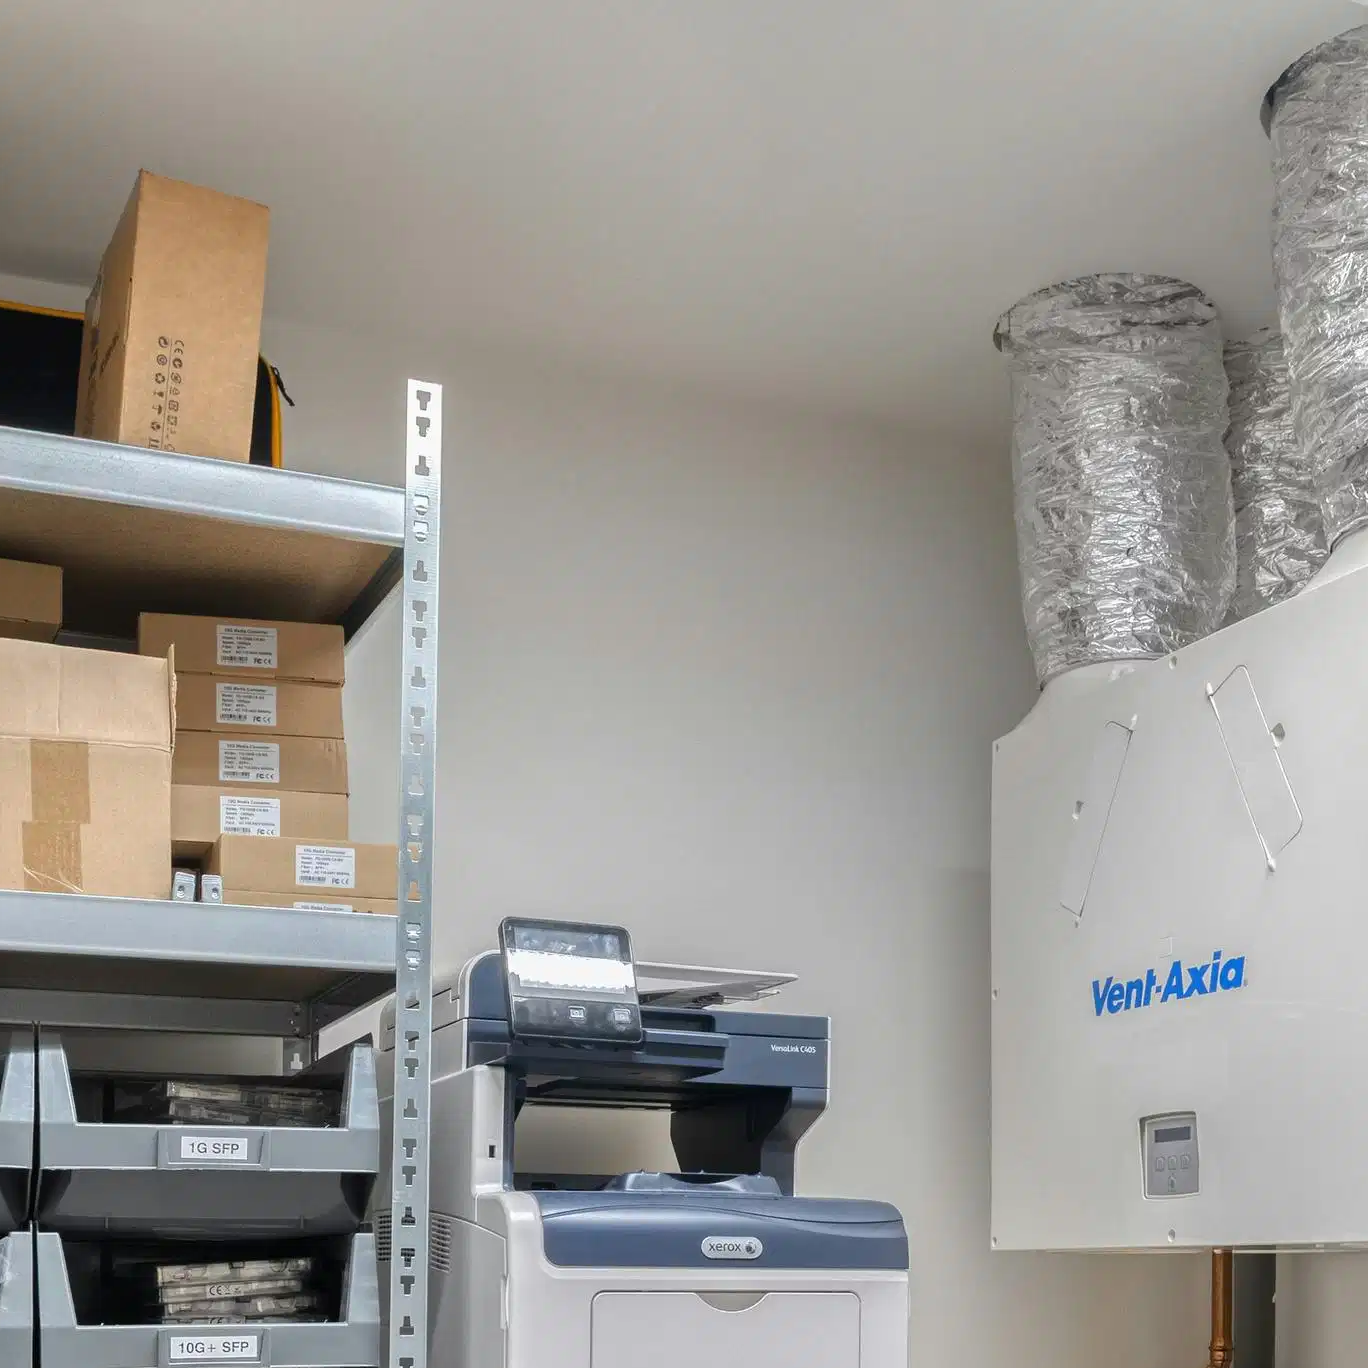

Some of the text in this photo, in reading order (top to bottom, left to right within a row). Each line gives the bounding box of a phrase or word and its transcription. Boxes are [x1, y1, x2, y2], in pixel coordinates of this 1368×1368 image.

[1092, 950, 1245, 1016] Vent-Axia
[800, 1045, 817, 1054] C405
[189, 1142, 240, 1155] 1G SFP
[709, 1243, 741, 1252] xerox
[178, 1341, 249, 1354] 10G+ SFP
